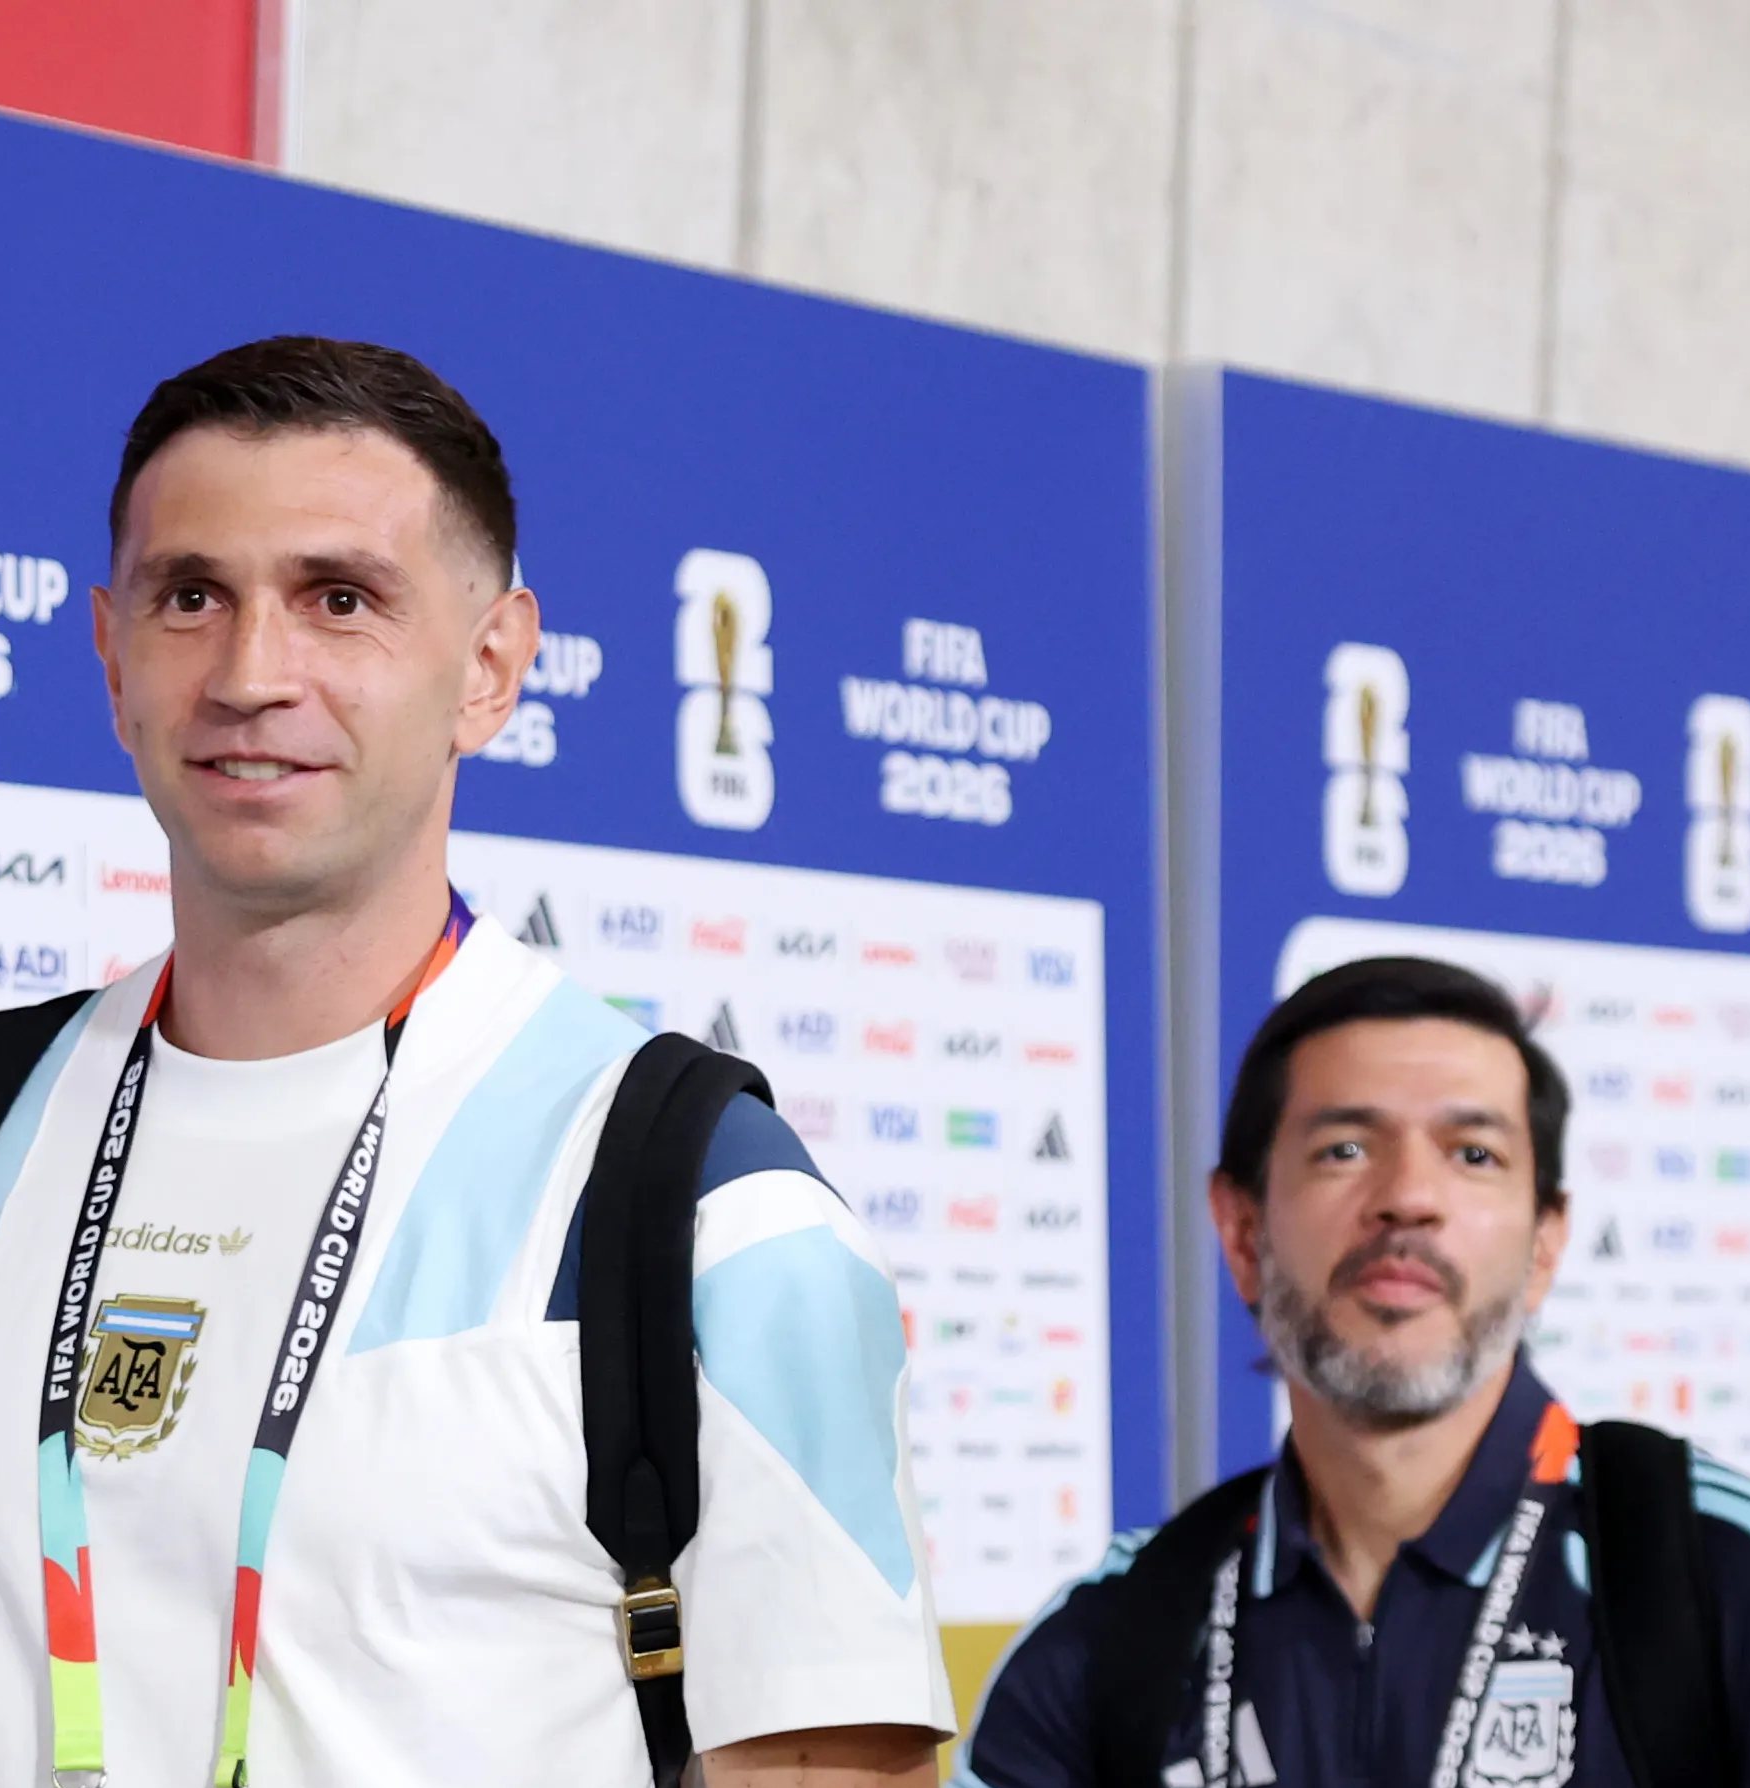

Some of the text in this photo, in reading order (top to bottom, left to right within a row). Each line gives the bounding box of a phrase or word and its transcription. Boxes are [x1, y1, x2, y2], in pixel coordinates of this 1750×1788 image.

[904, 618, 987, 686] FIFA
[840, 675, 1050, 763] WORLD CUP
[882, 751, 1012, 825] 2026
[51, 1061, 144, 1400] FIFA WORLD CUP 2026
[103, 1222, 211, 1254] adidas
[275, 1123, 381, 1412] WORLD CUP 2026
